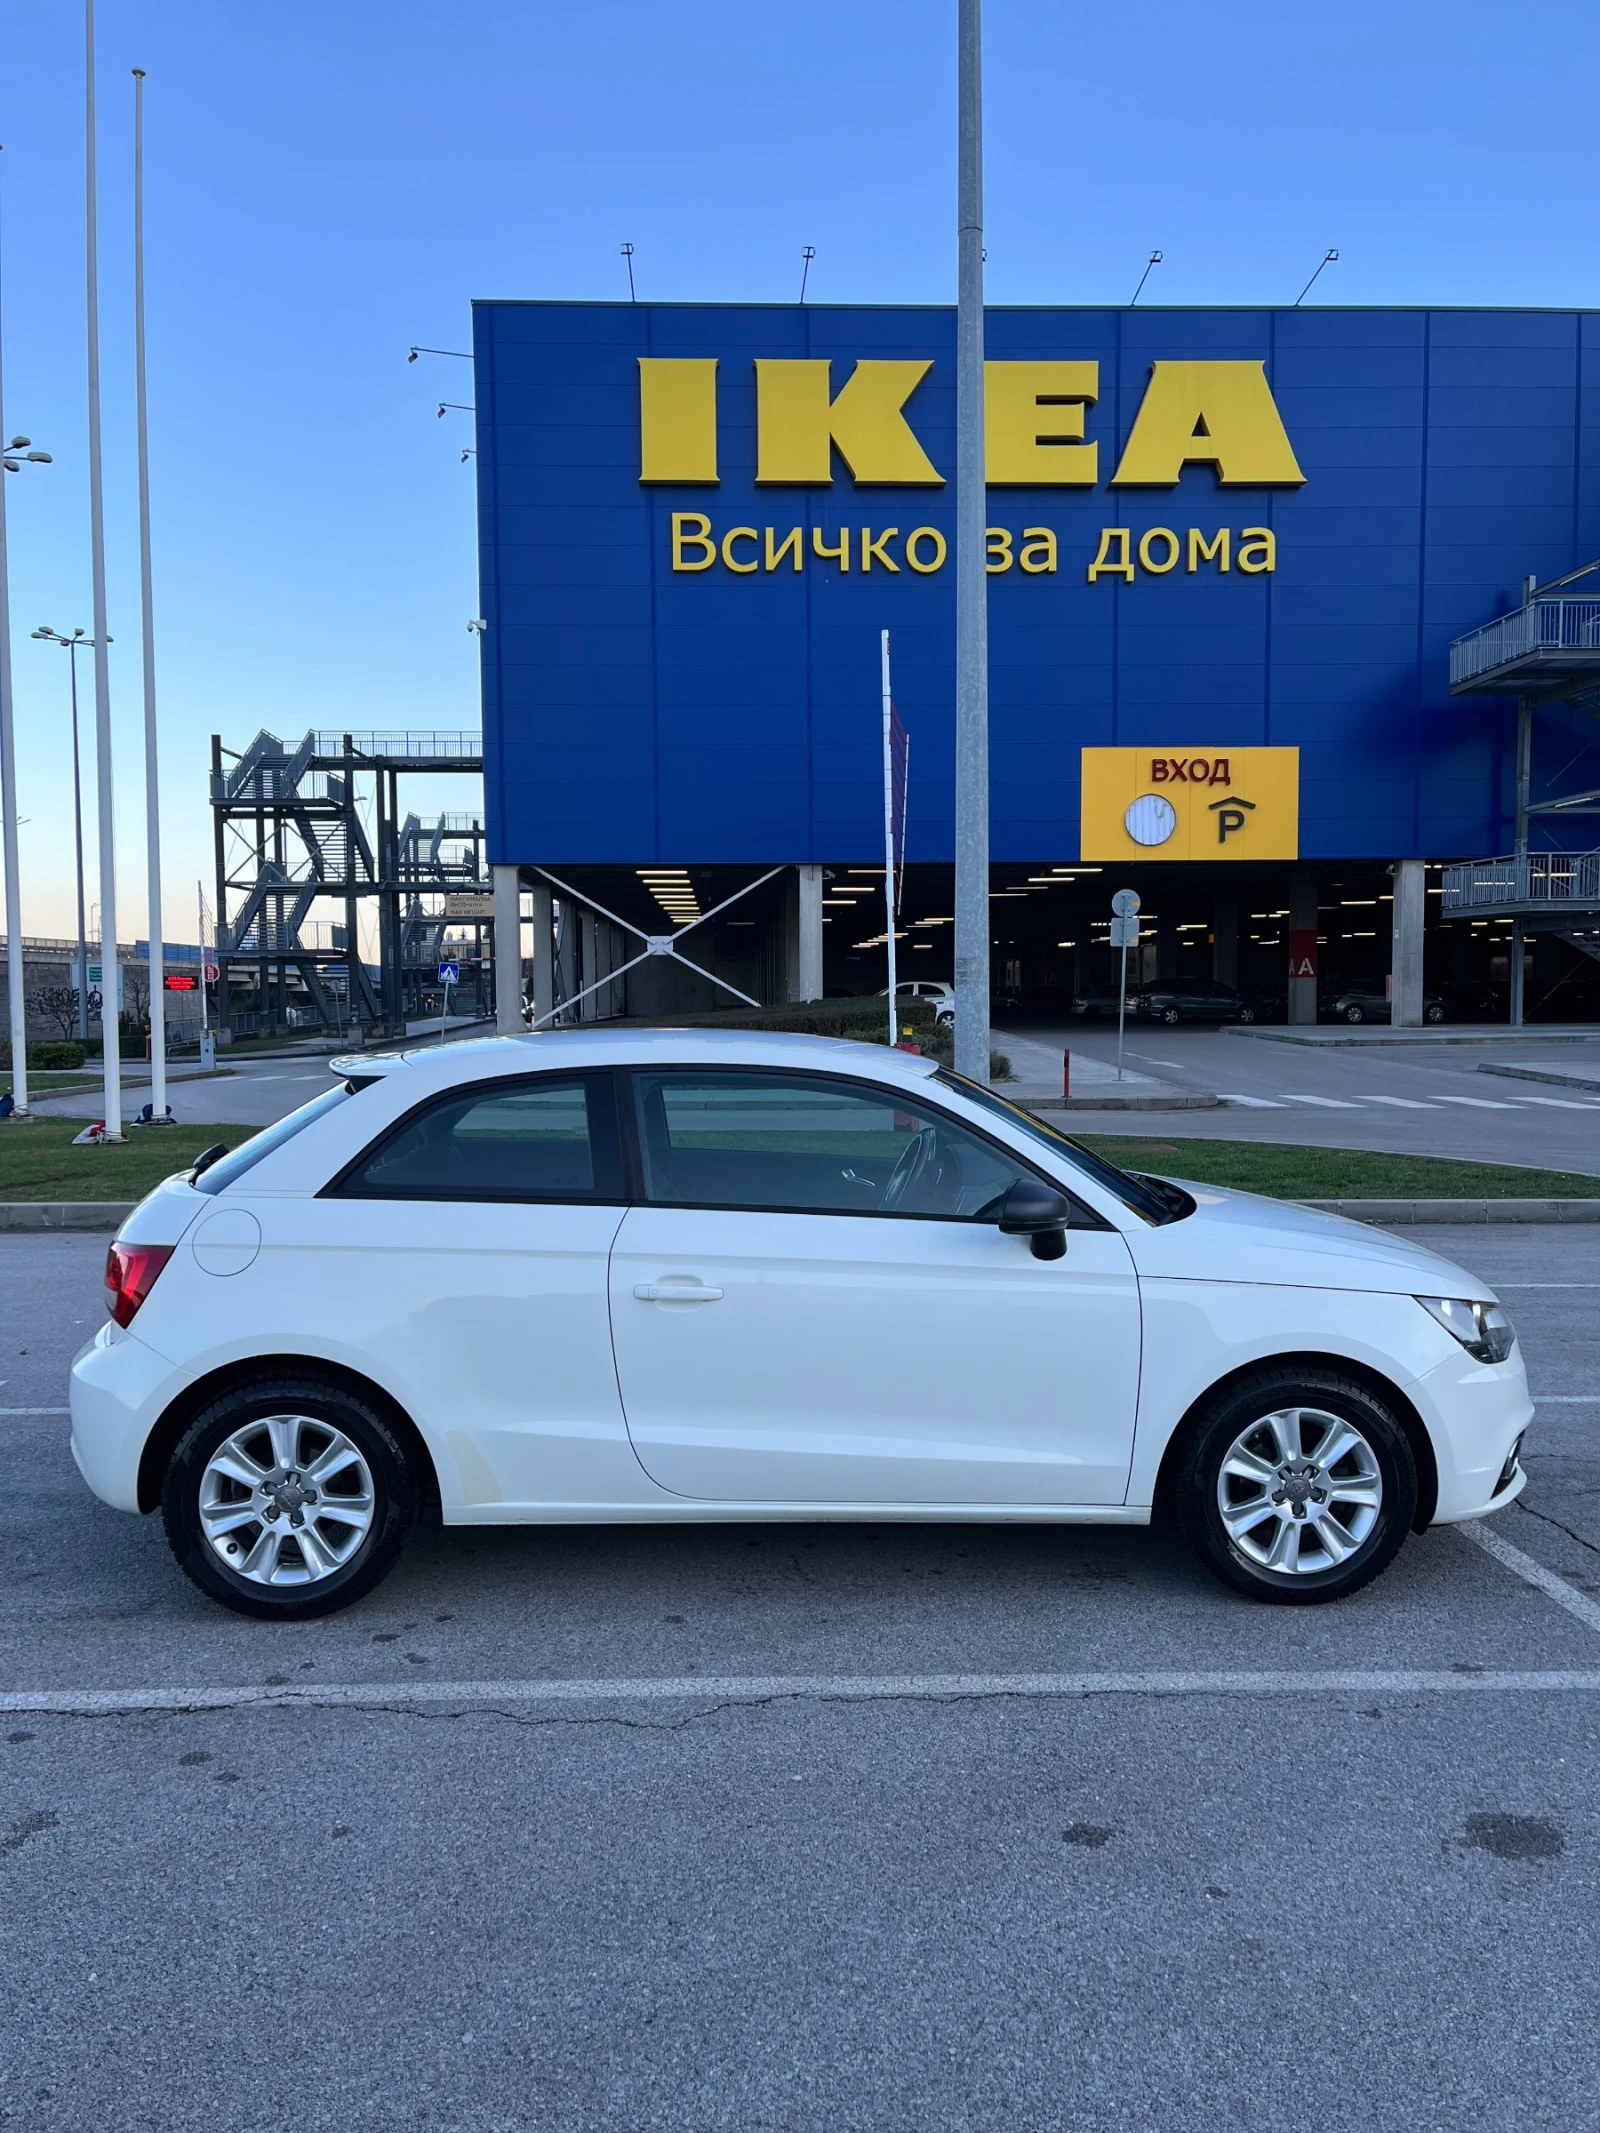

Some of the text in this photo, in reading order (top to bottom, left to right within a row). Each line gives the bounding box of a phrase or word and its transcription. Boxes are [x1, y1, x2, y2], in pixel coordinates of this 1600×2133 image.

[637, 357, 1307, 486] IKEA
[671, 512, 1276, 583] Всичко за дома
[1151, 758, 1231, 786] ВХОД
[1218, 810, 1245, 844] P
[1298, 957, 1314, 974] A
